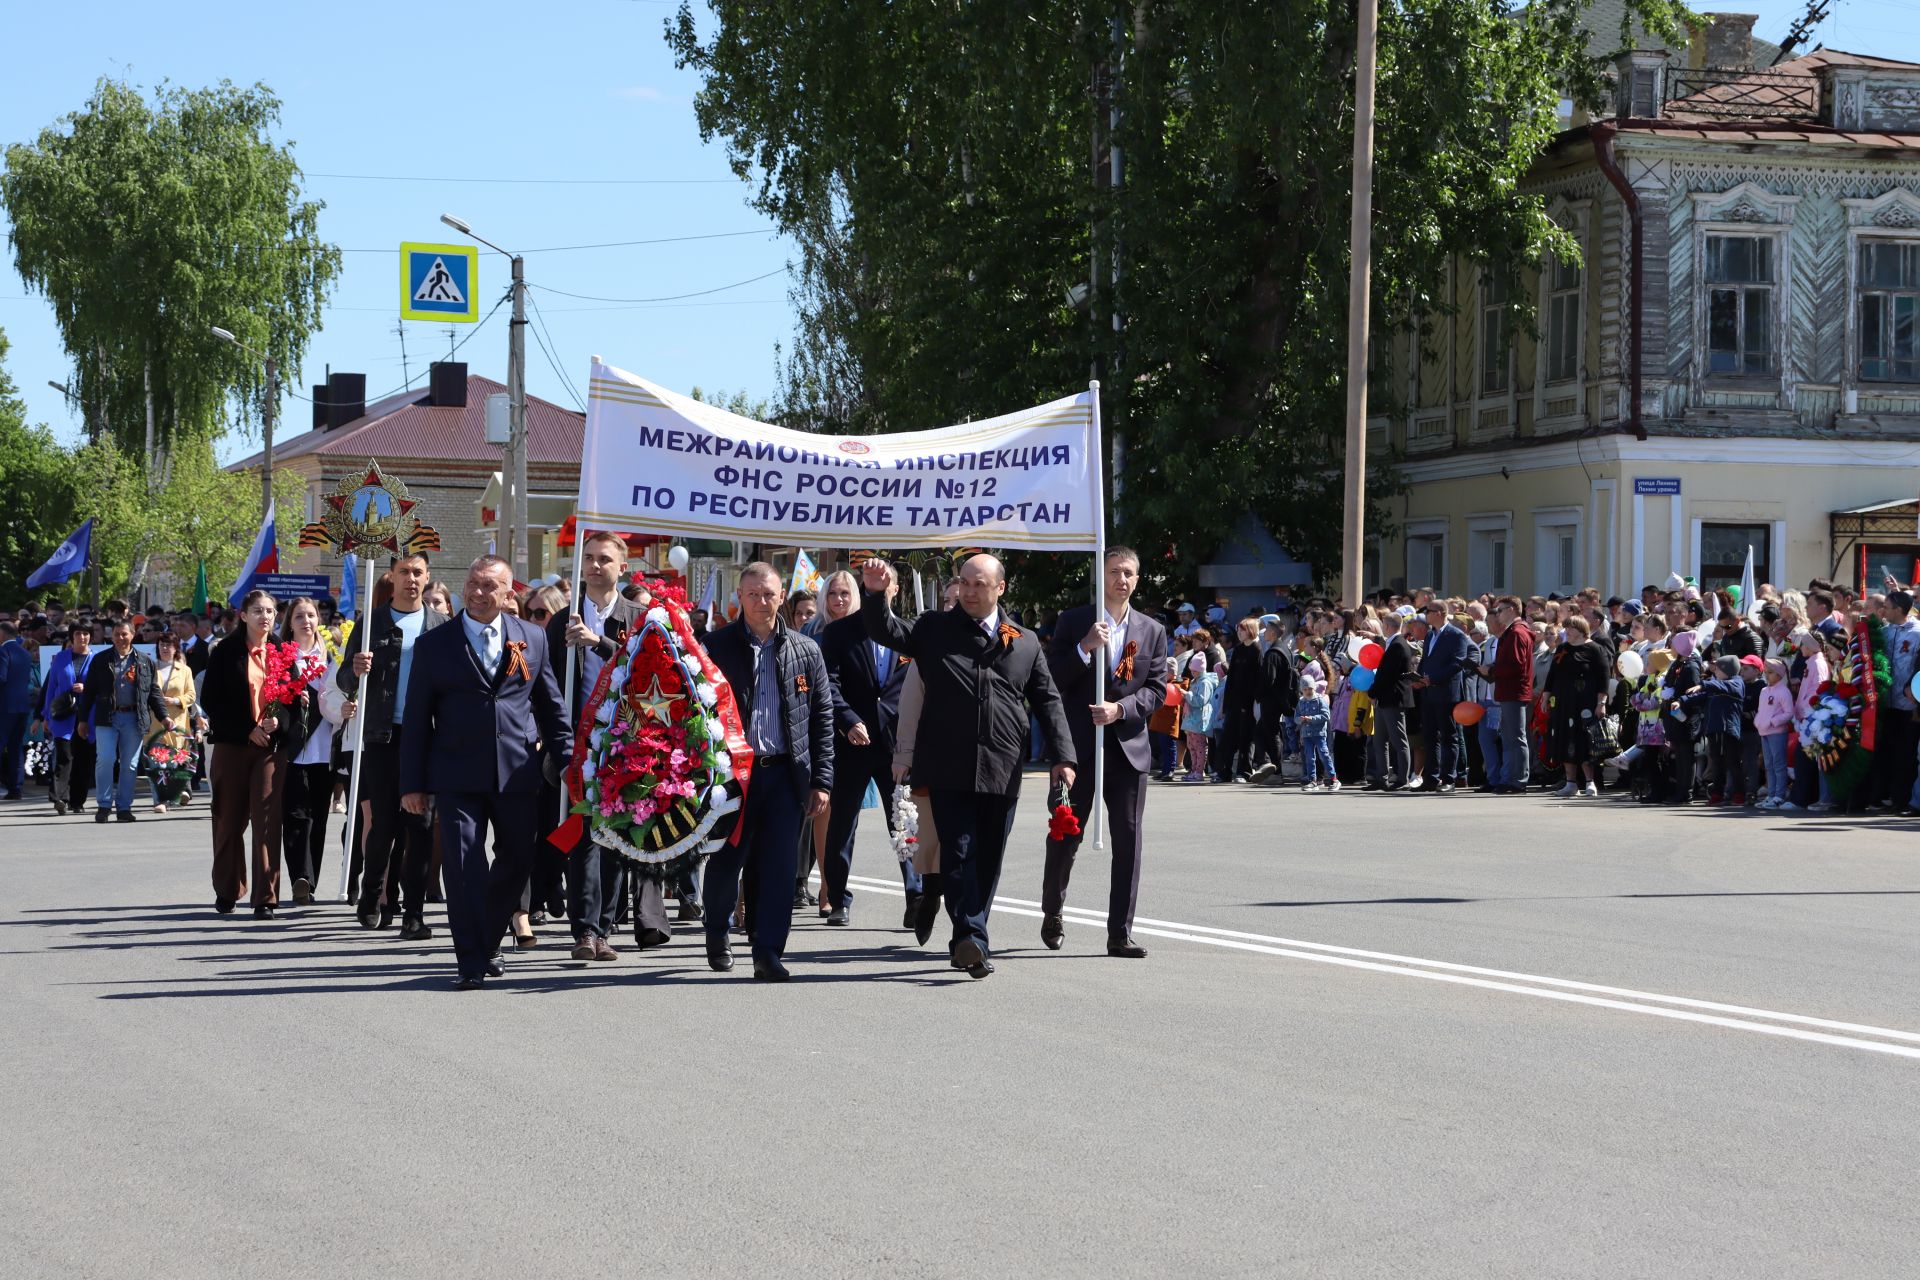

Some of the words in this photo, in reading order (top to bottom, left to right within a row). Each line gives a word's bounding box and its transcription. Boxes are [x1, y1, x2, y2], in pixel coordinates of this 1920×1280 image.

[639, 426, 881, 469] МЕЖРАЙОННАЯ
[894, 445, 1070, 470] ИНСПЕКЦИЯ
[714, 465, 783, 492] ФНС
[796, 472, 922, 499] РОССИИ
[935, 477, 997, 499] №12
[632, 485, 675, 510] ПО
[689, 491, 894, 525] РЕСПУБЛИКЕ
[906, 502, 1071, 527] ТАТАРСТАН
[356, 533, 387, 543] ПОБЕДА
